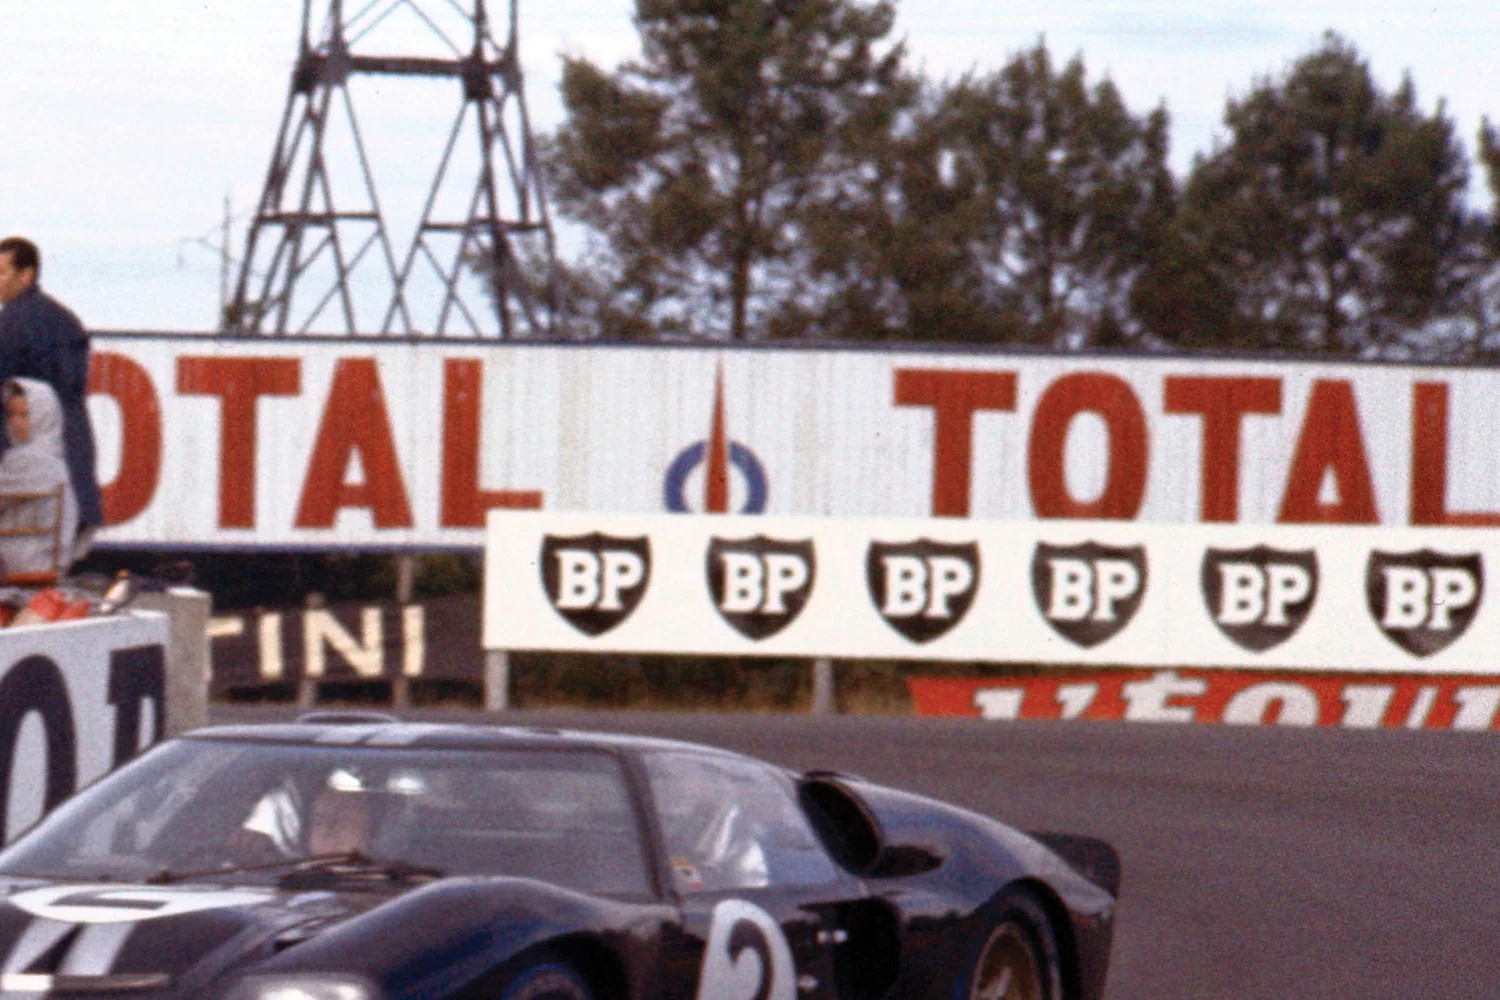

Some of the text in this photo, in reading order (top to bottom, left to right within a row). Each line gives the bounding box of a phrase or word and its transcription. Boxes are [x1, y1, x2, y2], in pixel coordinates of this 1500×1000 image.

[893, 367, 1500, 525] TOTAL
[555, 549, 1477, 631] BP BP BP BP BP BP
